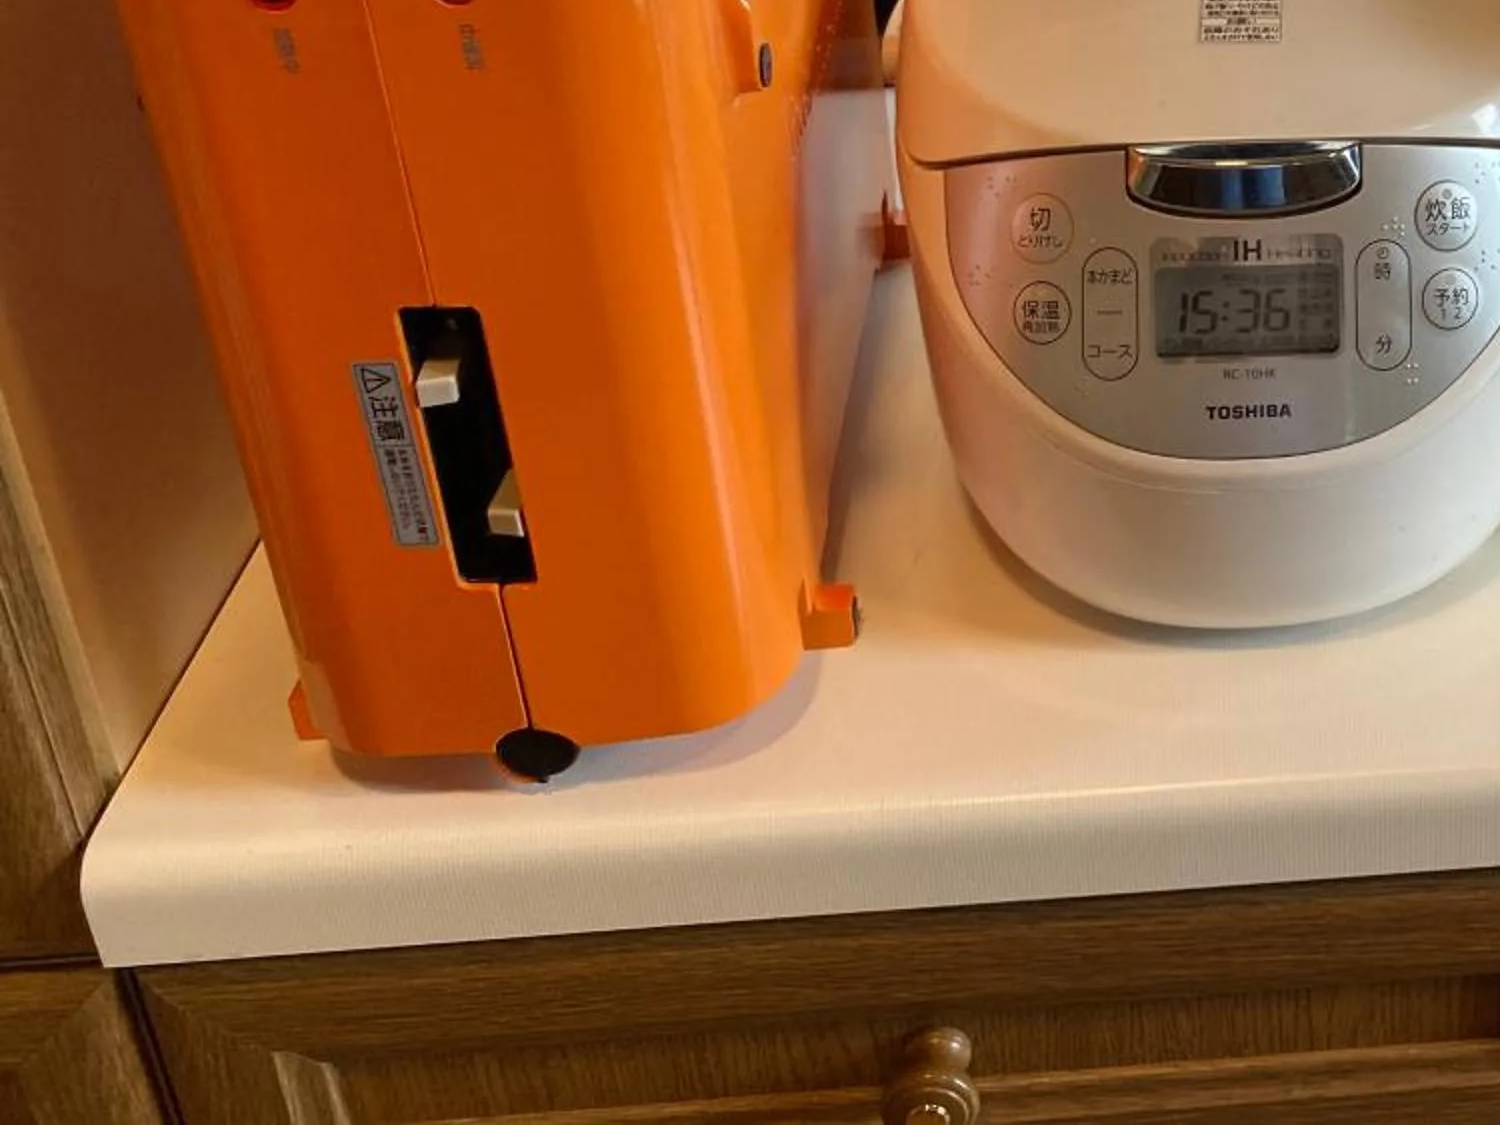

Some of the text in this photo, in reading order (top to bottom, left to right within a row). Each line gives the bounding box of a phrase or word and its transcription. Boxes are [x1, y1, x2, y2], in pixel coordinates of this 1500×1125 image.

[1425, 196, 1471, 221] 炊飯
[1030, 207, 1051, 231] 切
[1426, 222, 1470, 235] スタート
[1233, 239, 1262, 262] IH
[1375, 262, 1391, 280] 時
[1434, 287, 1469, 307] 予約
[1022, 300, 1060, 318] 保温
[1179, 289, 1291, 334] 15:36
[1087, 344, 1133, 360] コース
[1376, 334, 1392, 354] 分
[1205, 403, 1292, 420] TOSHIBA
